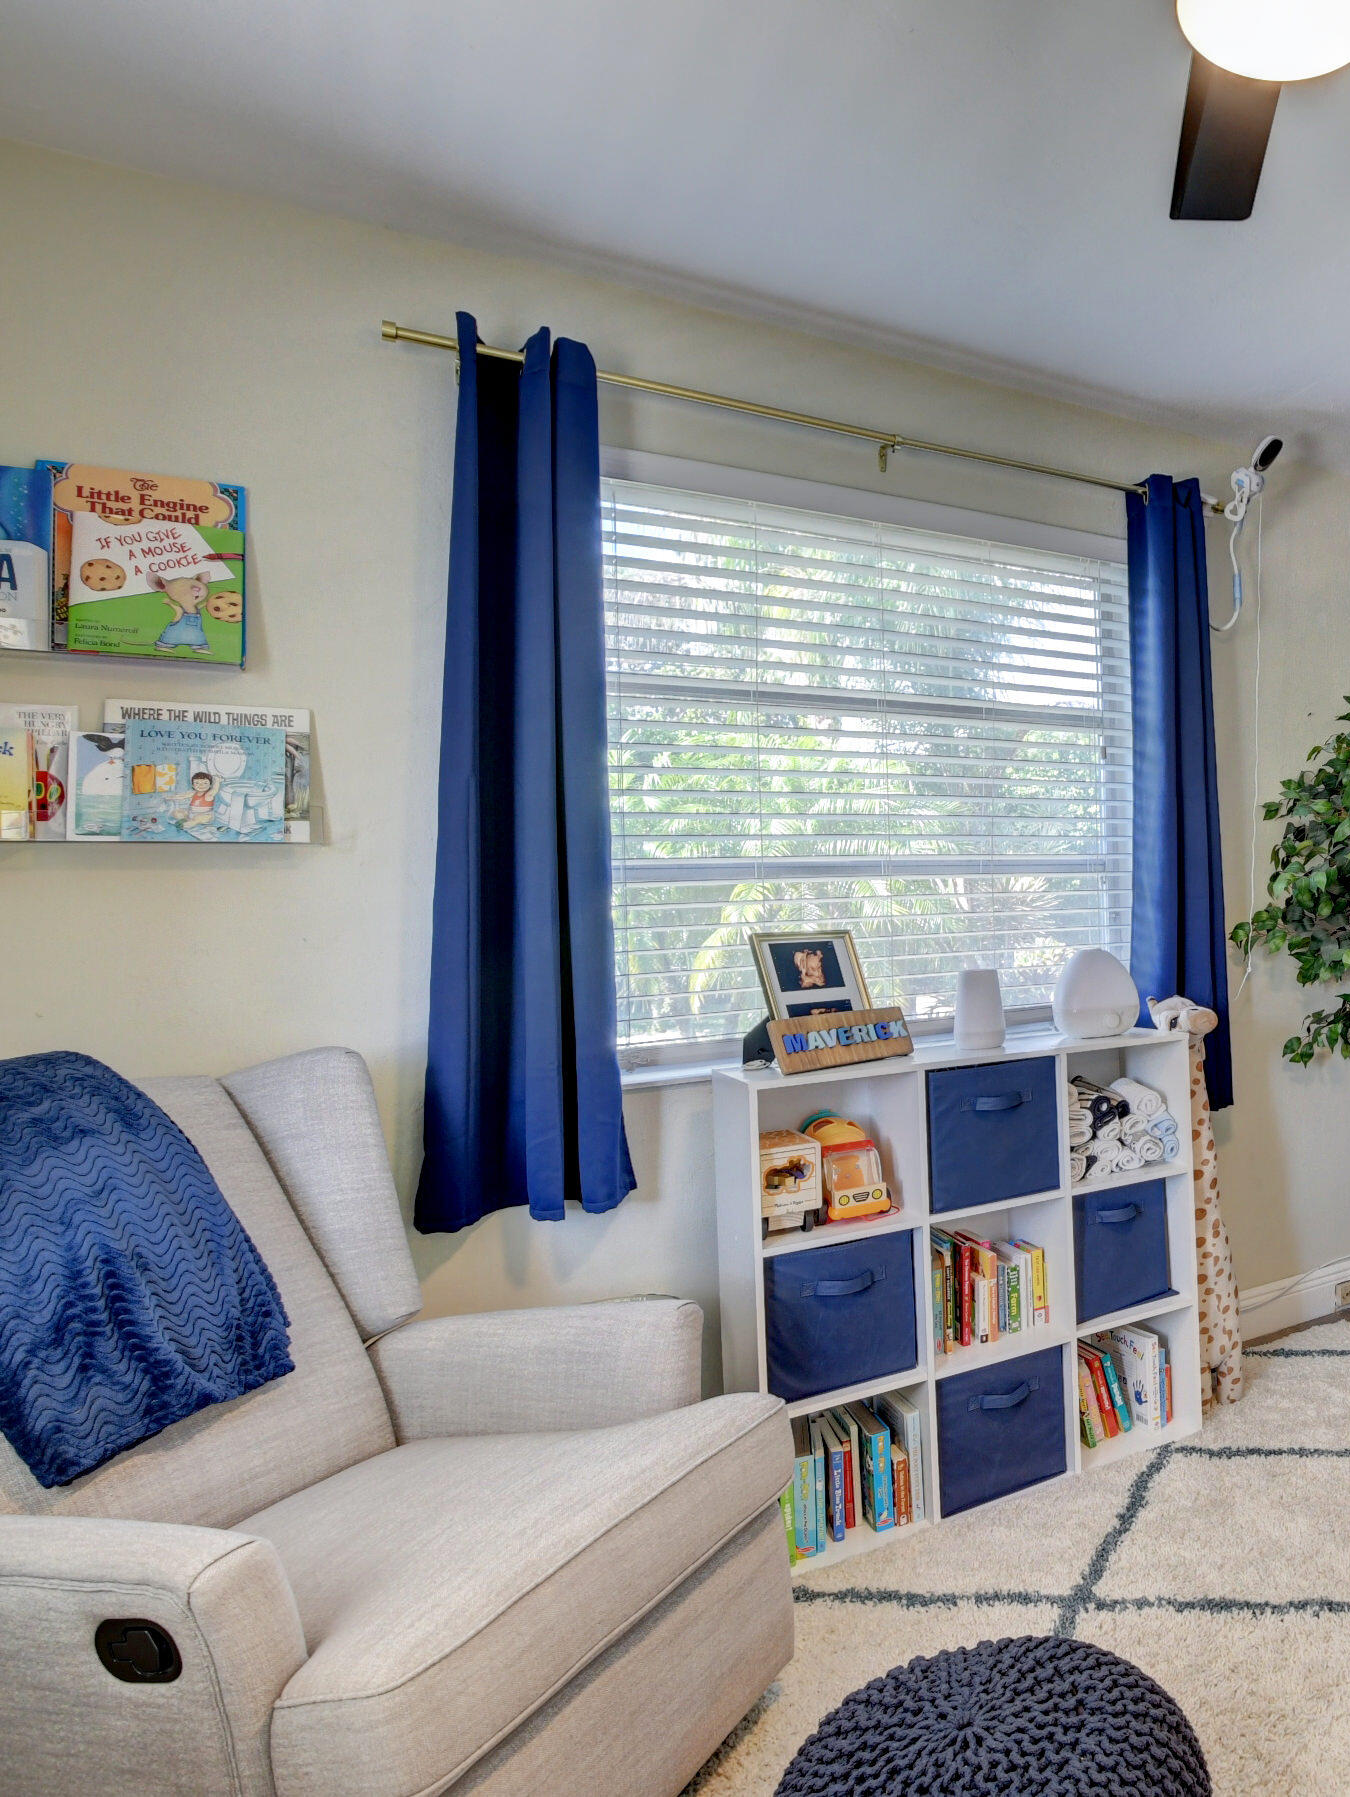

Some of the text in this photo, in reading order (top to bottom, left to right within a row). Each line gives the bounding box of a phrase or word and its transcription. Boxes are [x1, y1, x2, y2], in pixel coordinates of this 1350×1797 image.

[130, 477, 159, 492] The
[76, 485, 210, 514] Little Engine
[86, 500, 200, 526] That Could
[96, 527, 182, 550] IF YOU GIVE
[128, 541, 192, 561] A MOUSE
[134, 553, 203, 576] A COOKIE
[120, 706, 295, 728] WHERE THE WILD THINGS ARE
[140, 729, 177, 739] LOVE
[179, 731, 209, 741] YOU
[212, 733, 272, 746] FOREVER
[782, 1019, 909, 1055] MAVERICK
[1010, 1292, 1020, 1316] Farm
[833, 1469, 841, 1489] Little
[834, 1489, 842, 1504] Blue
